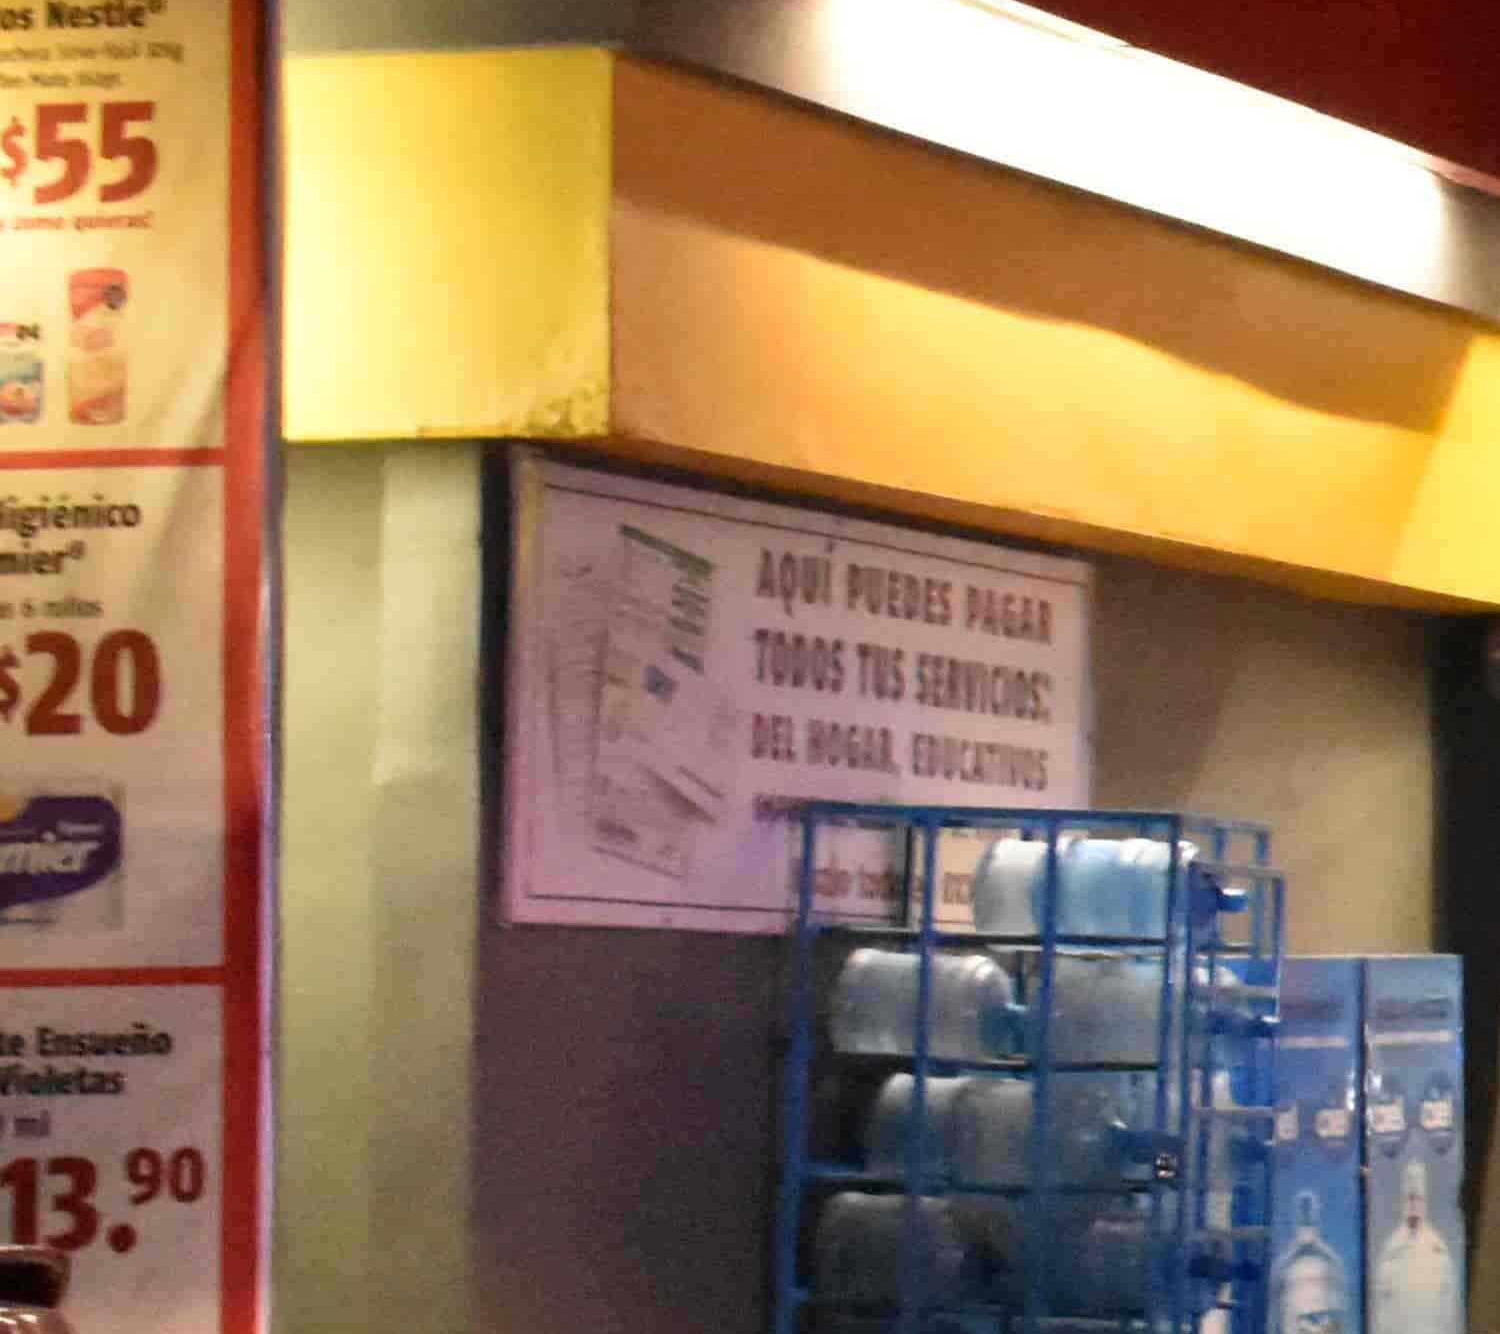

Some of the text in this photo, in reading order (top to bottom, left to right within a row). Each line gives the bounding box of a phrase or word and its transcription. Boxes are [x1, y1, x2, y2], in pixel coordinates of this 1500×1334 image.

[1, 100, 158, 204] $55
[756, 539, 1054, 645] AQUÍ PUEDES PAGAR
[0, 628, 161, 736] $20
[752, 628, 845, 693] TODOS
[856, 642, 905, 701] TUS
[751, 711, 797, 763] DEL
